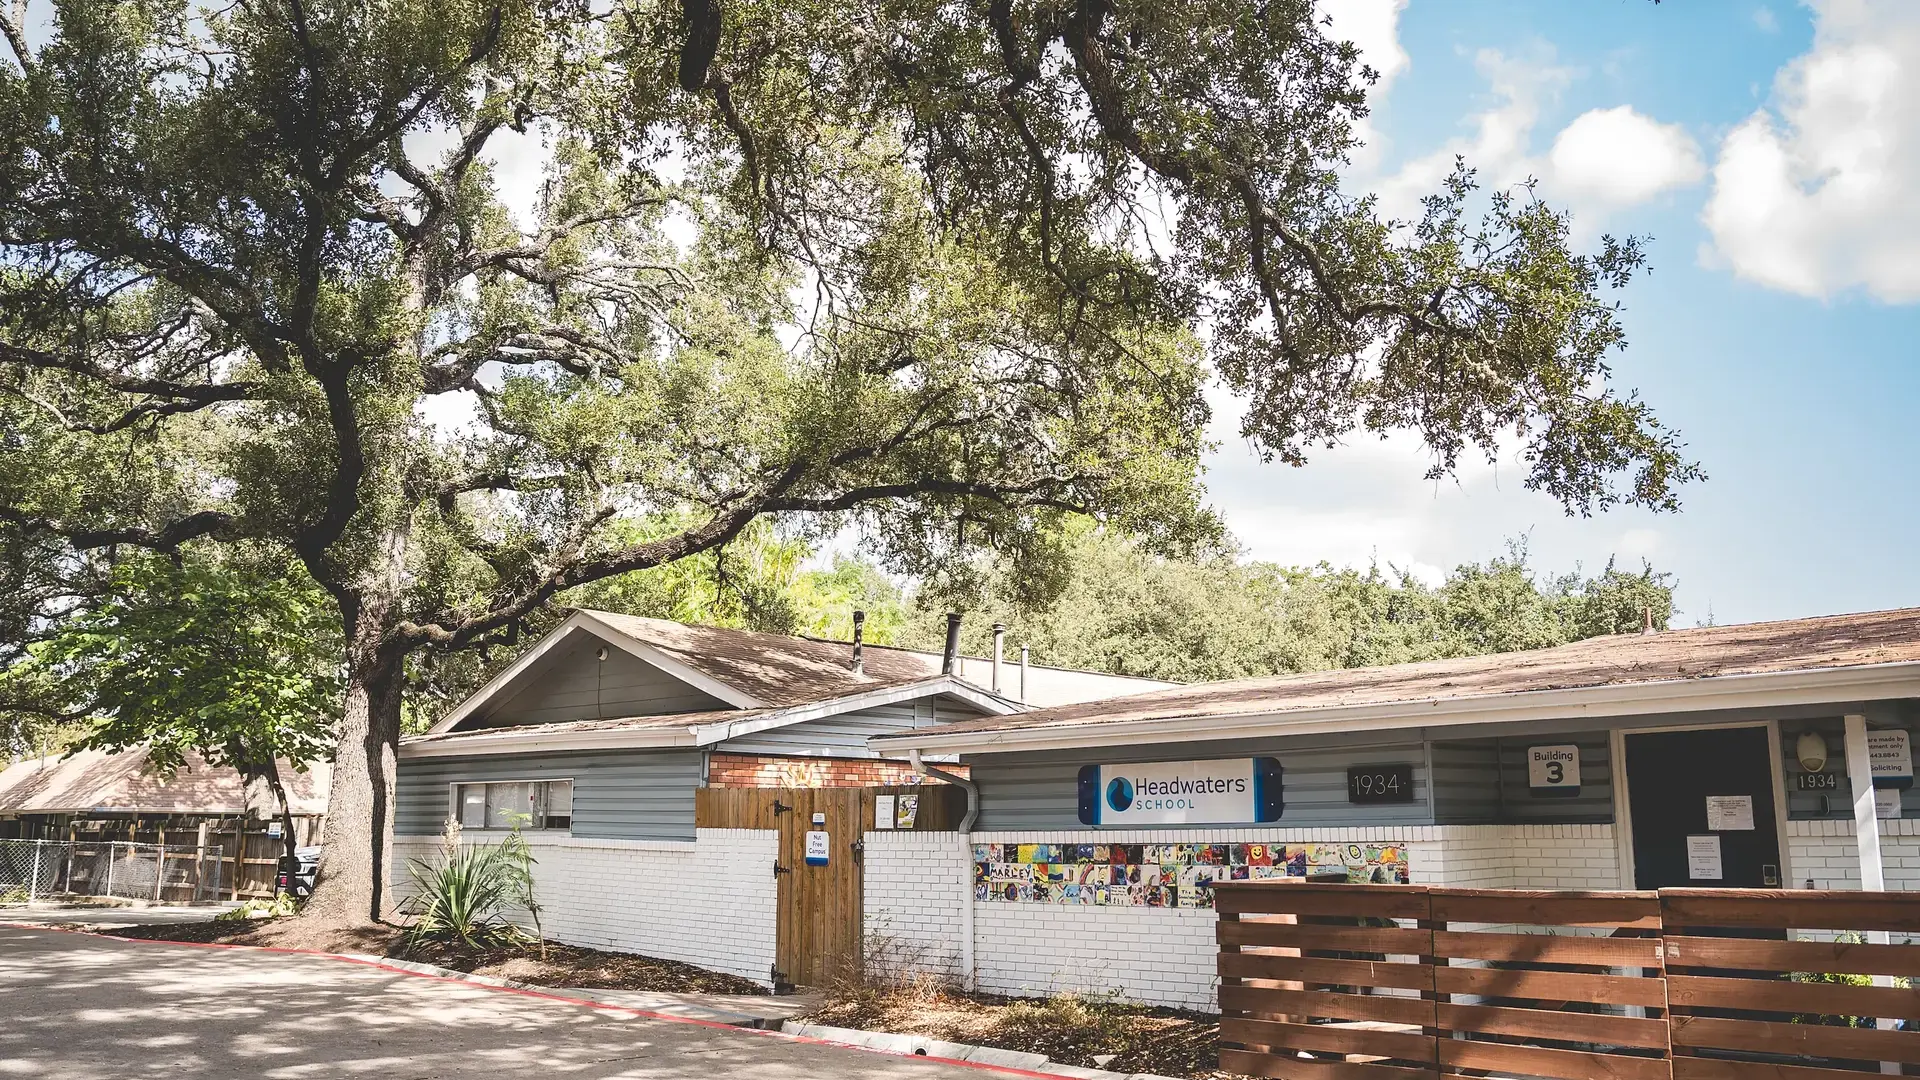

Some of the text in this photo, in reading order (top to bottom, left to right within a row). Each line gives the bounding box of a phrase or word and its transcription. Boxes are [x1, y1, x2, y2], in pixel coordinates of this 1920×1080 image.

[1897, 735, 1904, 743] by
[1534, 750, 1573, 761] Building
[1545, 760, 1564, 784] 3
[1870, 764, 1902, 772] Soliciting
[1354, 774, 1399, 795] 1934
[1800, 774, 1835, 788] 1934
[1136, 799, 1195, 810] SCHOOL
[990, 868, 1030, 878] MARLEY
